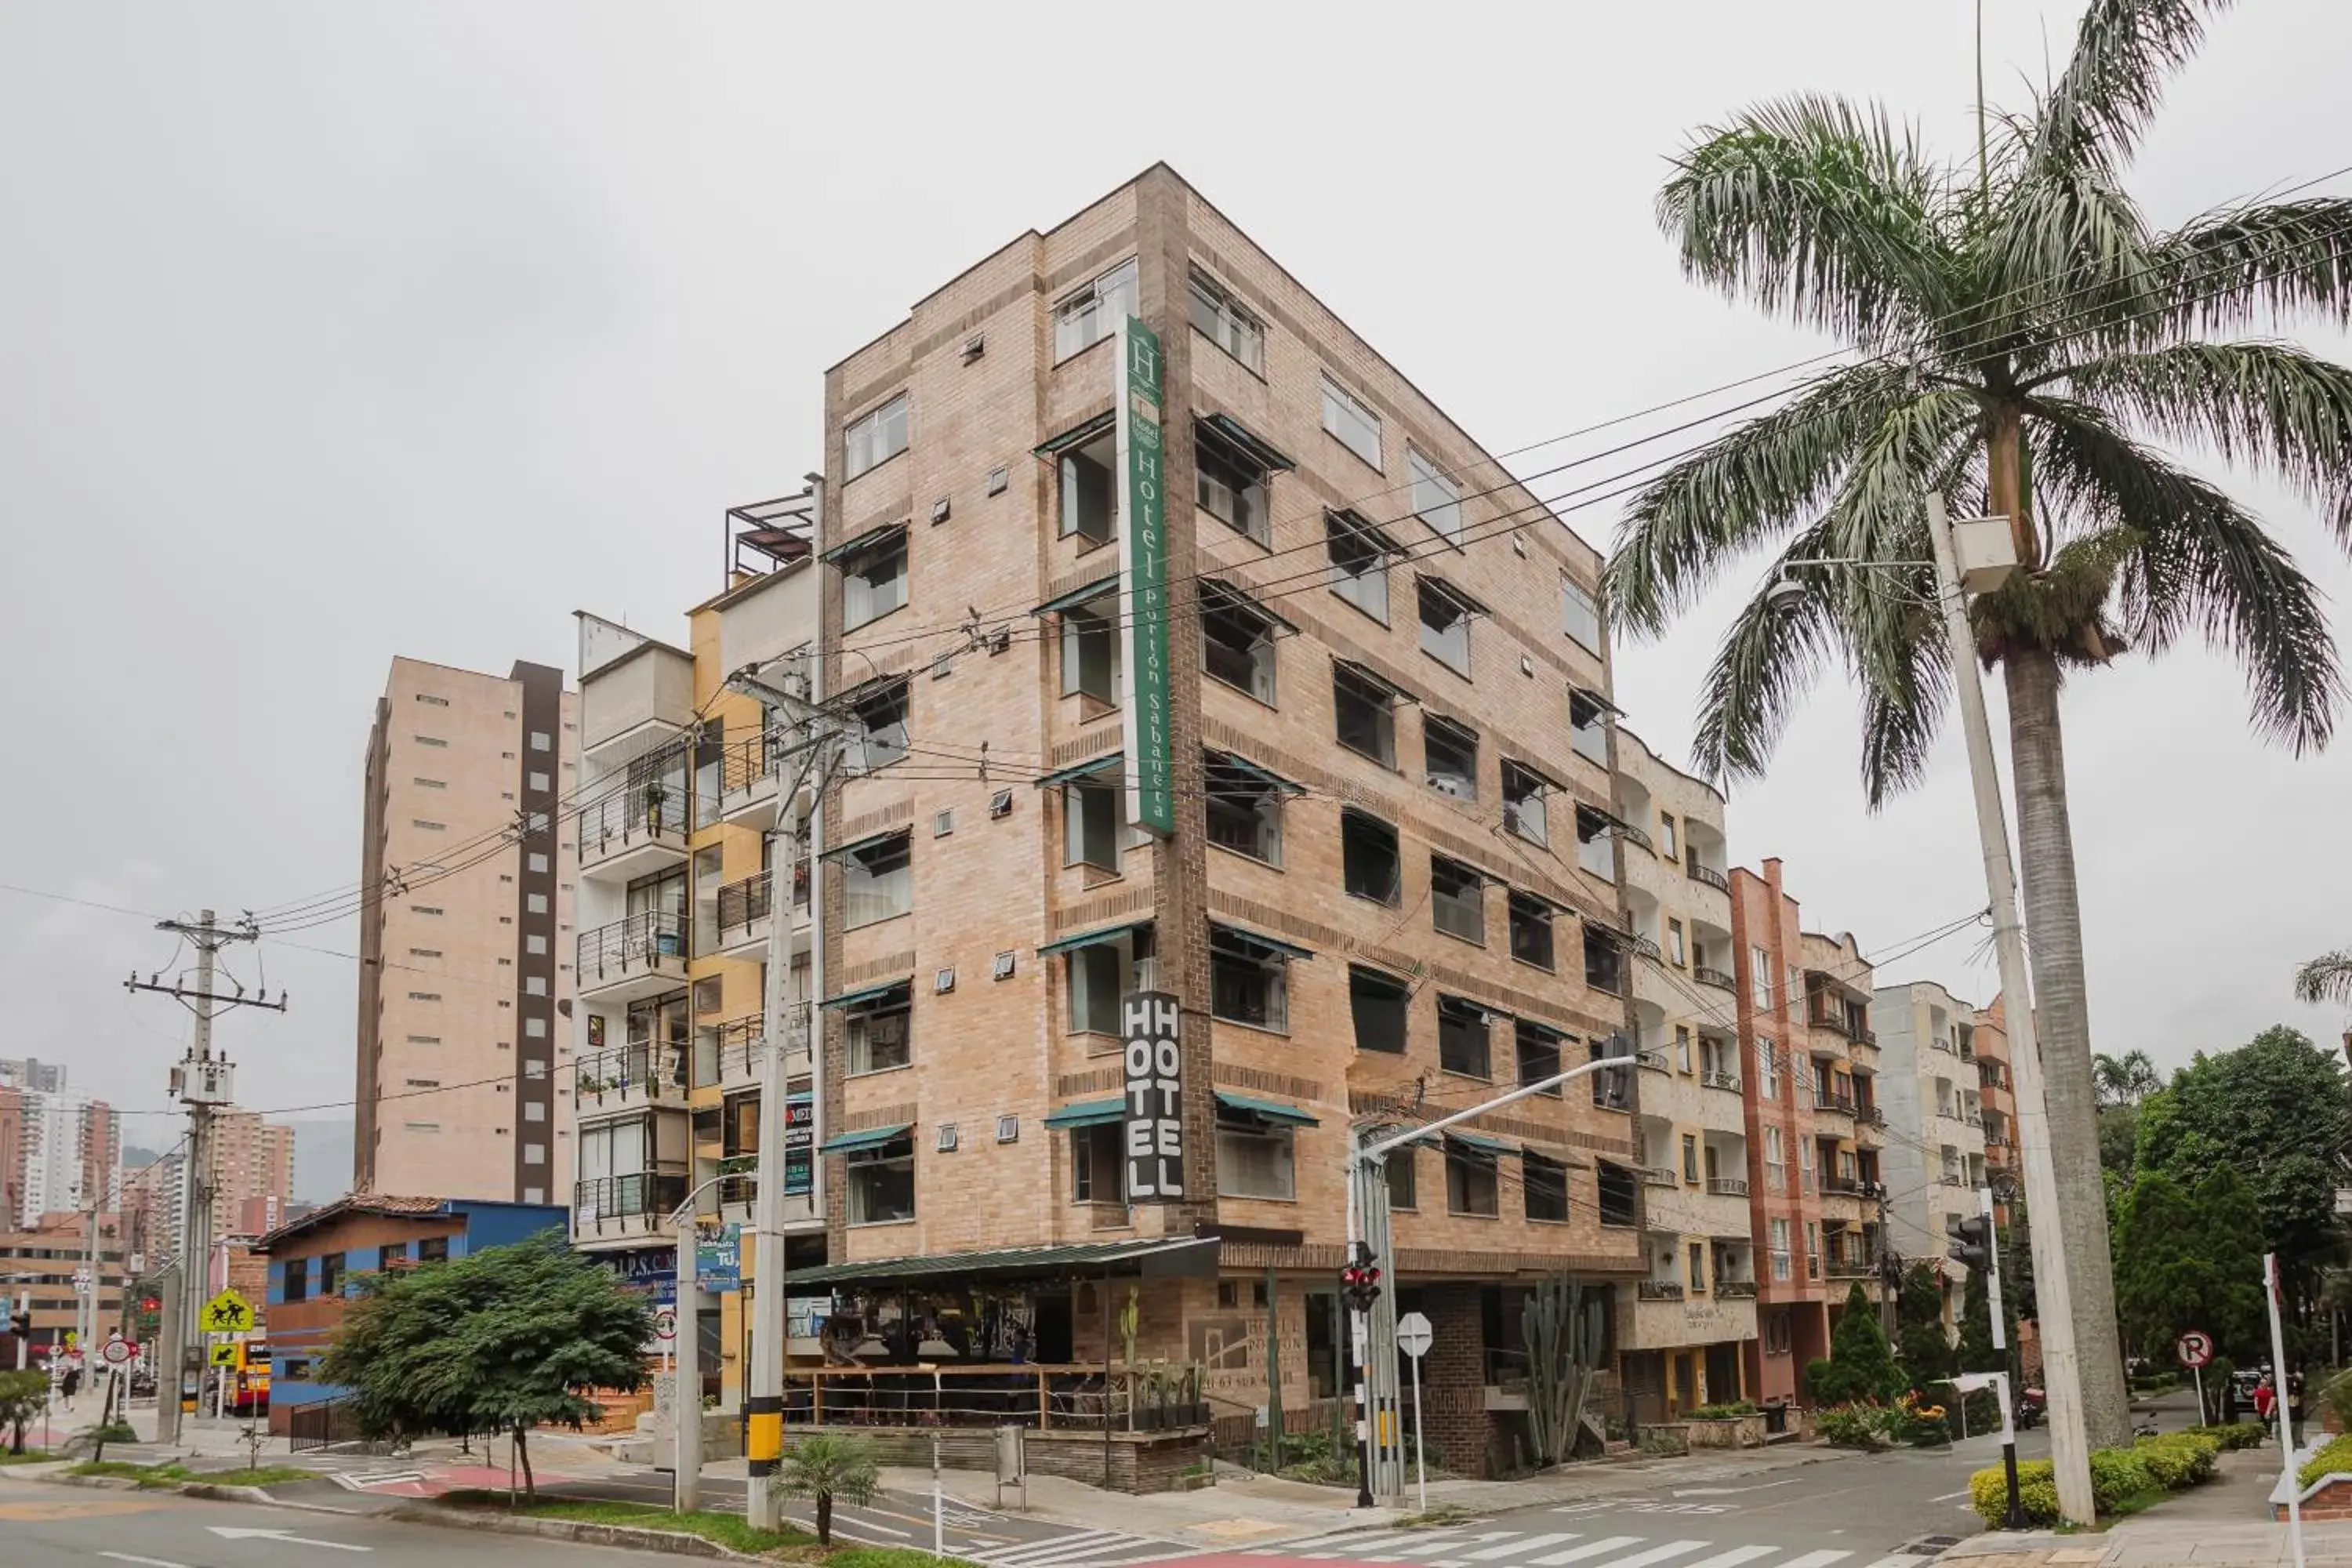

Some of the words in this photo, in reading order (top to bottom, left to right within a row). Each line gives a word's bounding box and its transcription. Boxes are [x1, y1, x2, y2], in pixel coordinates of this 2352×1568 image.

[1138, 451, 1156, 579] Hotel
[1125, 999, 1154, 1197] HOTEL
[1154, 999, 1182, 1196] HOTEL
[2187, 1337, 2204, 1360] P
